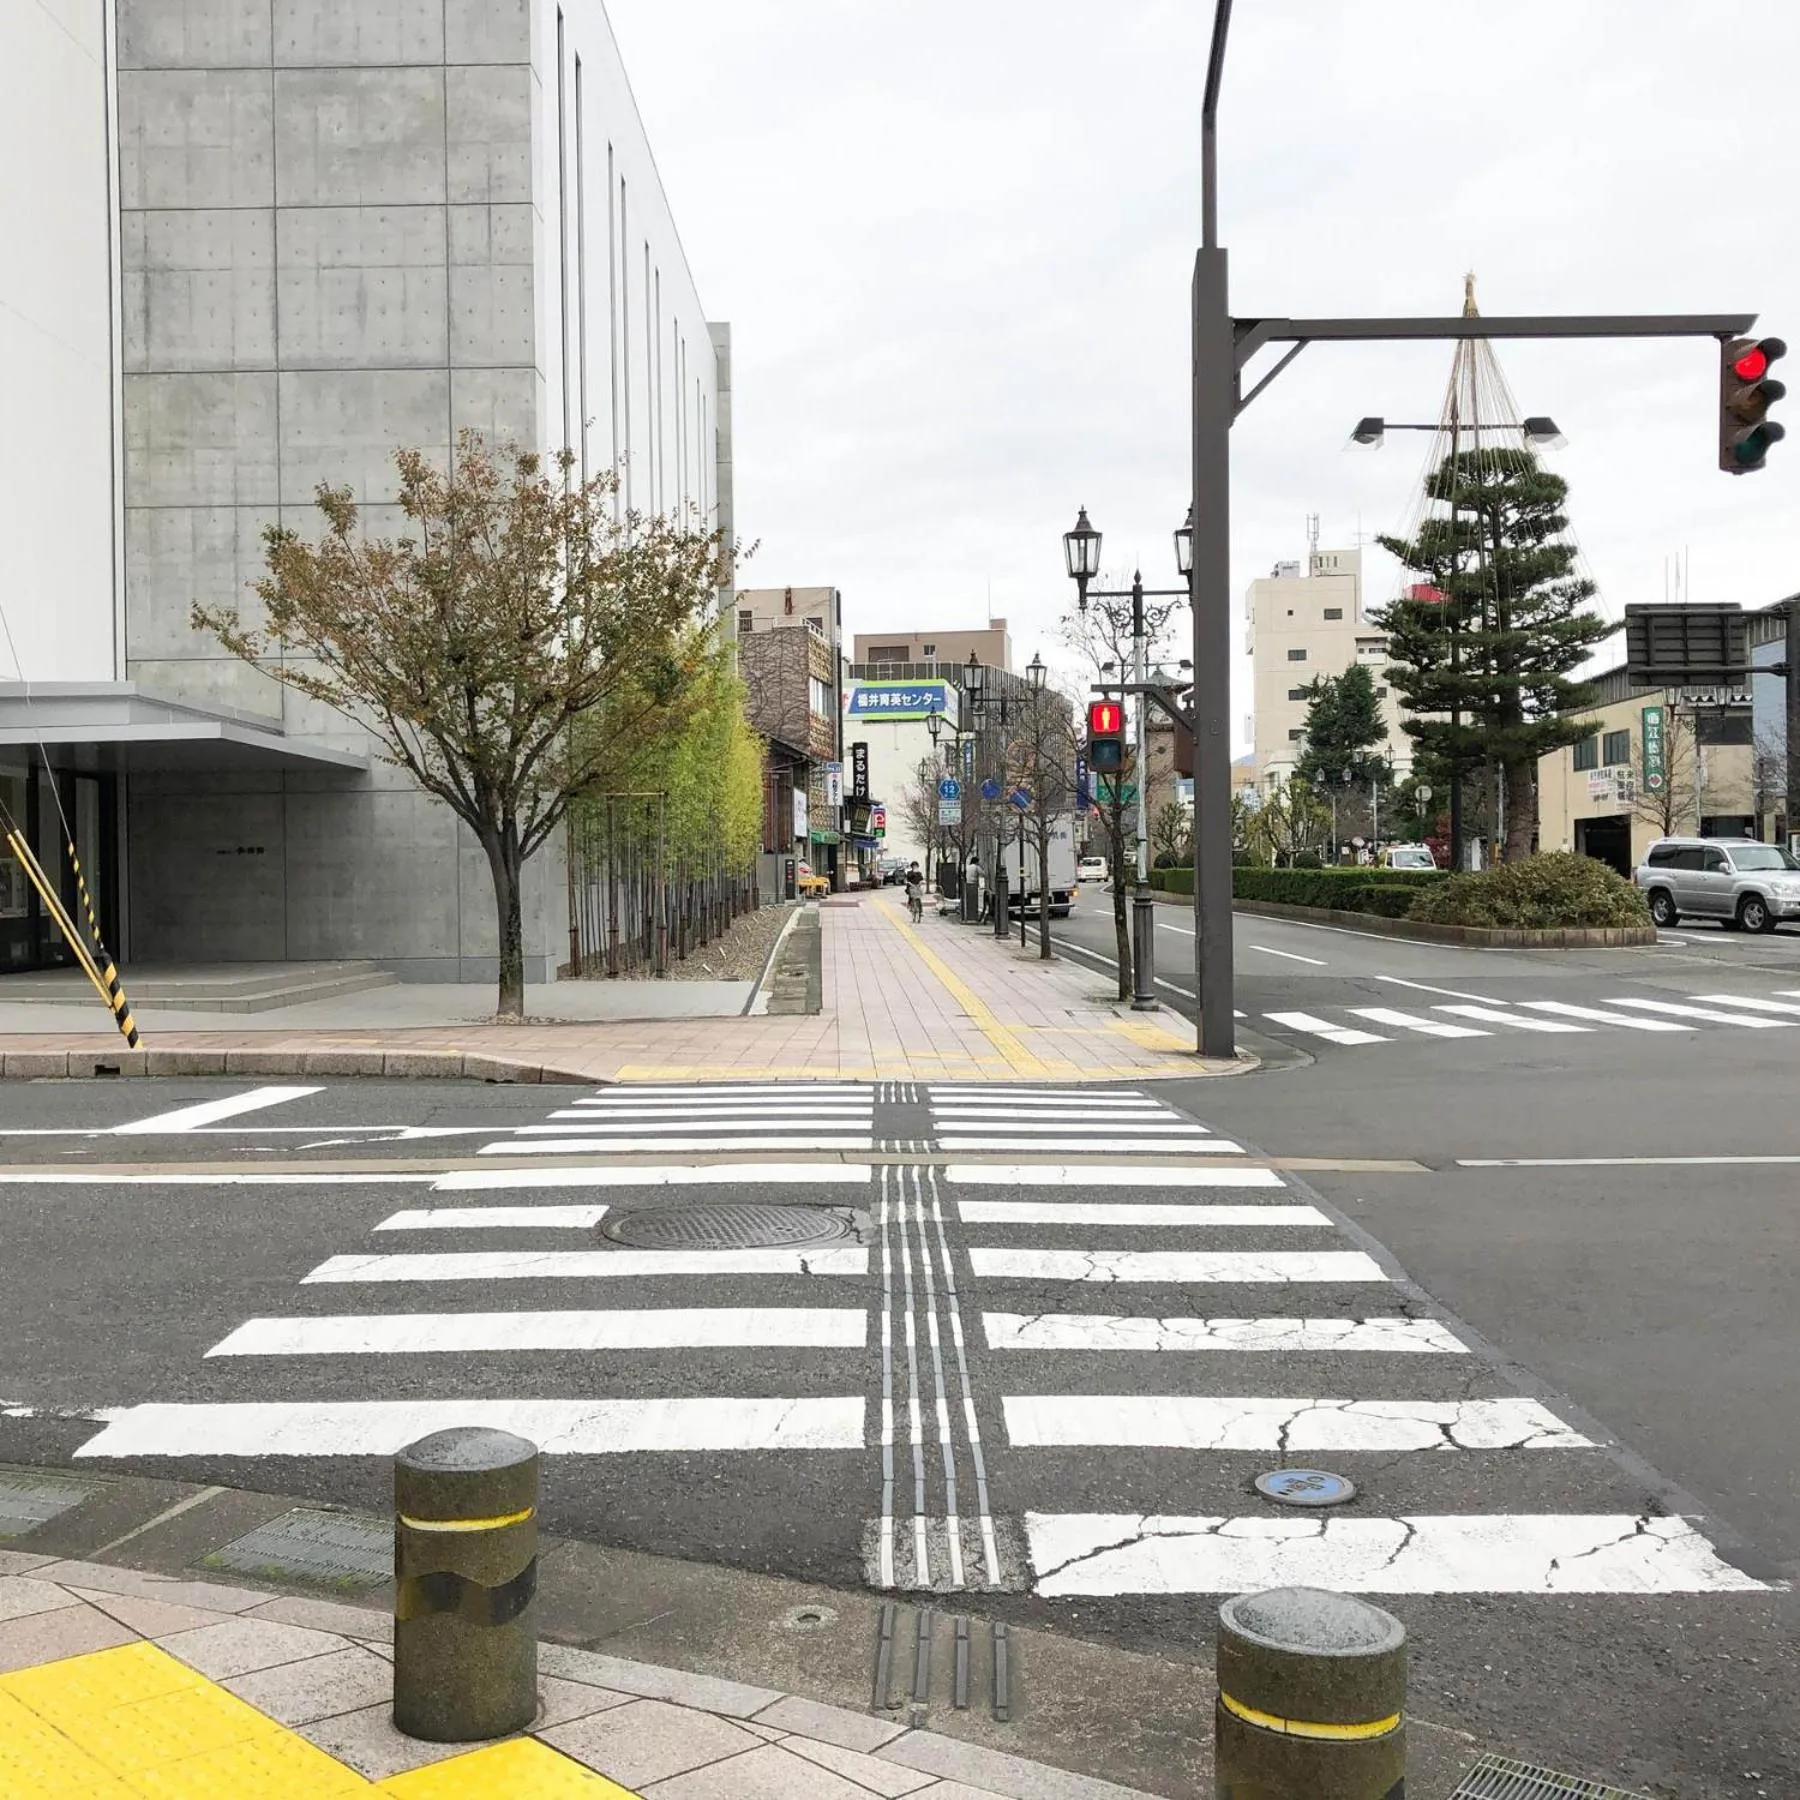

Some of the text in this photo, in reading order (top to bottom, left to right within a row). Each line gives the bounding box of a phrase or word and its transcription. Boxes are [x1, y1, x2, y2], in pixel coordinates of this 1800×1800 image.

[855, 748, 866, 797] まるたけ
[943, 785, 955, 793] 12
